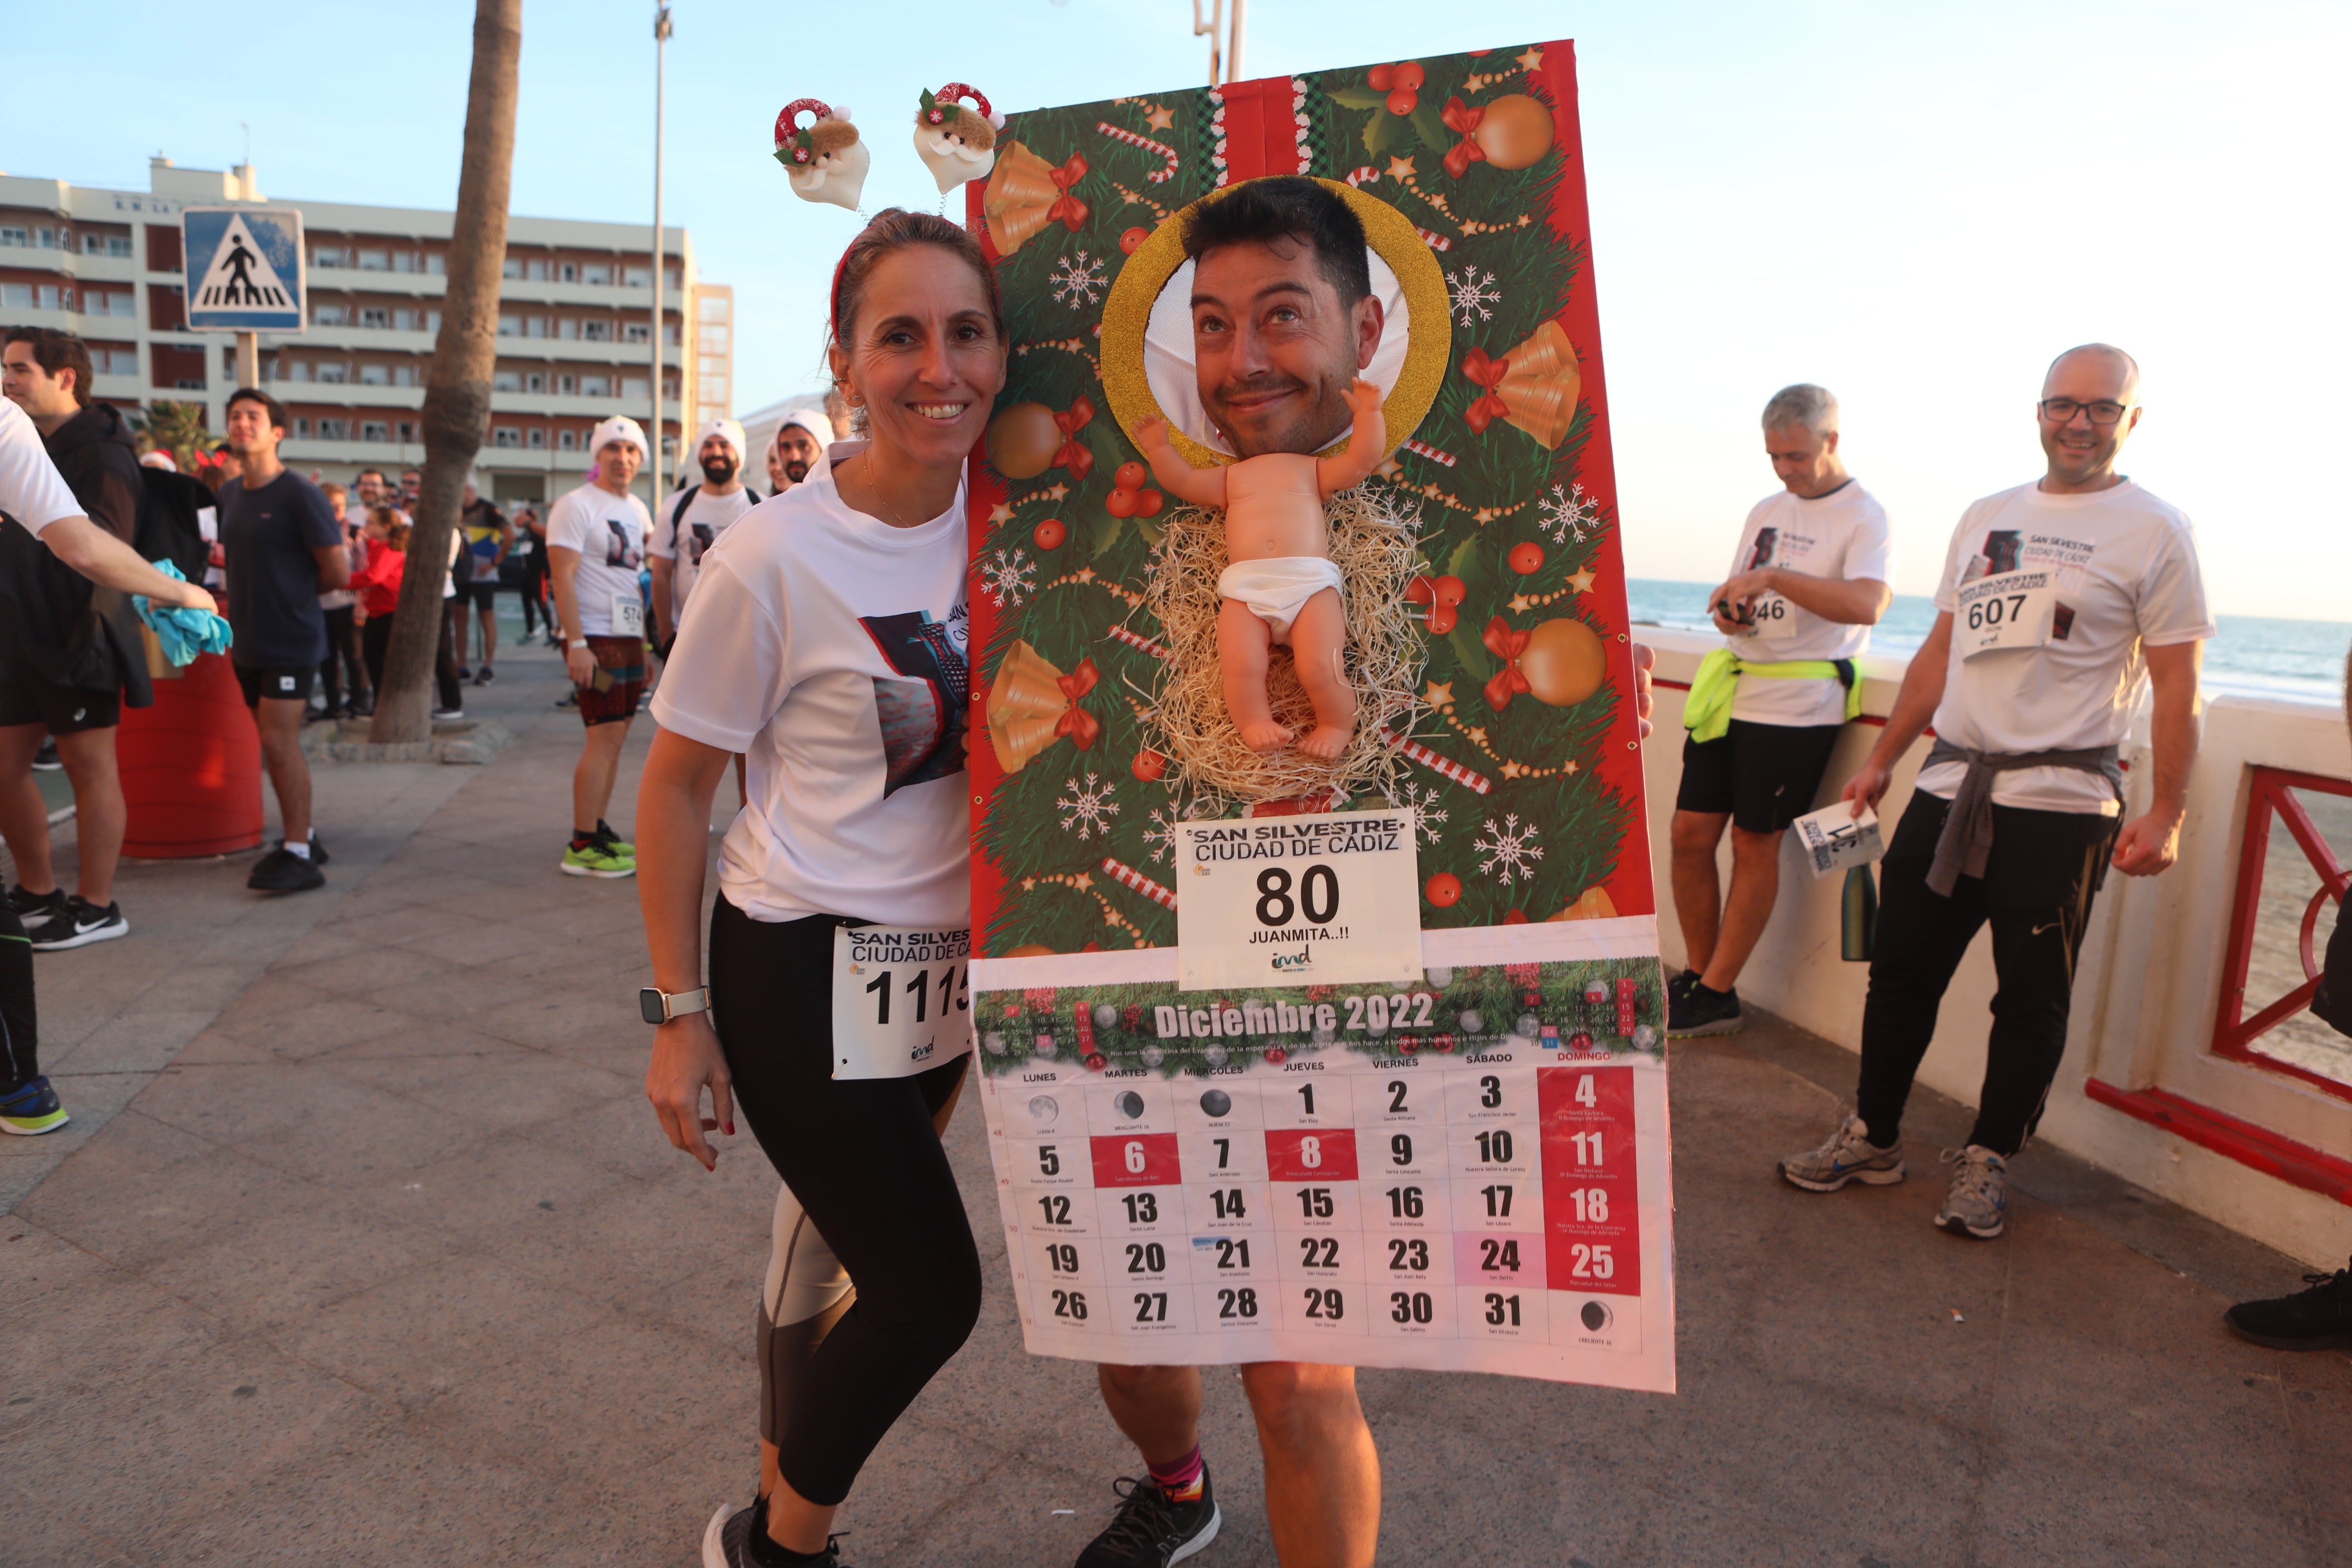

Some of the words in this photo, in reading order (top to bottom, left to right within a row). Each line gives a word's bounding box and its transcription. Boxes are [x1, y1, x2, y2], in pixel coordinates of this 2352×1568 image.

[1969, 594, 2027, 630] 607
[1193, 828, 1247, 843] SAN
[1255, 819, 1398, 839] SILVESTRE
[1195, 840, 1285, 861] CIUDAD
[1292, 838, 1321, 857] DE
[1256, 864, 1339, 926] 80
[851, 933, 901, 945] SAN
[852, 946, 930, 962] CIUDAD
[935, 944, 955, 961] DE
[1249, 927, 1349, 944] JUANMITA..!!
[1155, 1000, 1337, 1038] Diciembre
[1344, 993, 1434, 1030] 2022
[1246, 1045, 1280, 1053] esperanza
[1469, 1034, 1487, 1043] Hijos
[1024, 1073, 1056, 1082] LUNES
[1104, 1069, 1148, 1079] MARTES
[1283, 1062, 1325, 1072] JUEVES
[1373, 1059, 1419, 1069] VIERNES
[1466, 1053, 1512, 1063] SÁBADO
[1558, 1052, 1611, 1061] DOMINGO
[1298, 1083, 1314, 1114] 1
[1388, 1081, 1408, 1113] 2
[1480, 1075, 1502, 1108] 3
[1575, 1074, 1596, 1108] 4
[1038, 1145, 1060, 1175] 5
[1124, 1141, 1145, 1173] 6
[1213, 1138, 1229, 1168] 7
[1301, 1135, 1321, 1168] 8
[1391, 1134, 1413, 1165] 9
[1474, 1130, 1513, 1163] 10
[1571, 1131, 1603, 1165] 11
[1038, 1195, 1072, 1224] 12
[1122, 1192, 1158, 1223] 13
[1210, 1189, 1246, 1218] 14
[1297, 1188, 1334, 1217] 15
[1386, 1186, 1424, 1218] 16
[1481, 1185, 1513, 1217] 17
[1570, 1188, 1609, 1223] 18
[1045, 1243, 1079, 1273] 19
[1125, 1242, 1165, 1273] 20
[1215, 1239, 1250, 1268] 21
[1300, 1238, 1339, 1268] 22
[1388, 1239, 1429, 1270] 23
[1481, 1239, 1521, 1271] 24
[1571, 1243, 1614, 1279] 25
[1052, 1289, 1088, 1320] 26
[1134, 1292, 1168, 1322] 27
[1217, 1288, 1258, 1318] 28
[1304, 1288, 1344, 1320] 29
[1390, 1292, 1433, 1324] 30
[1484, 1293, 1521, 1326] 31
